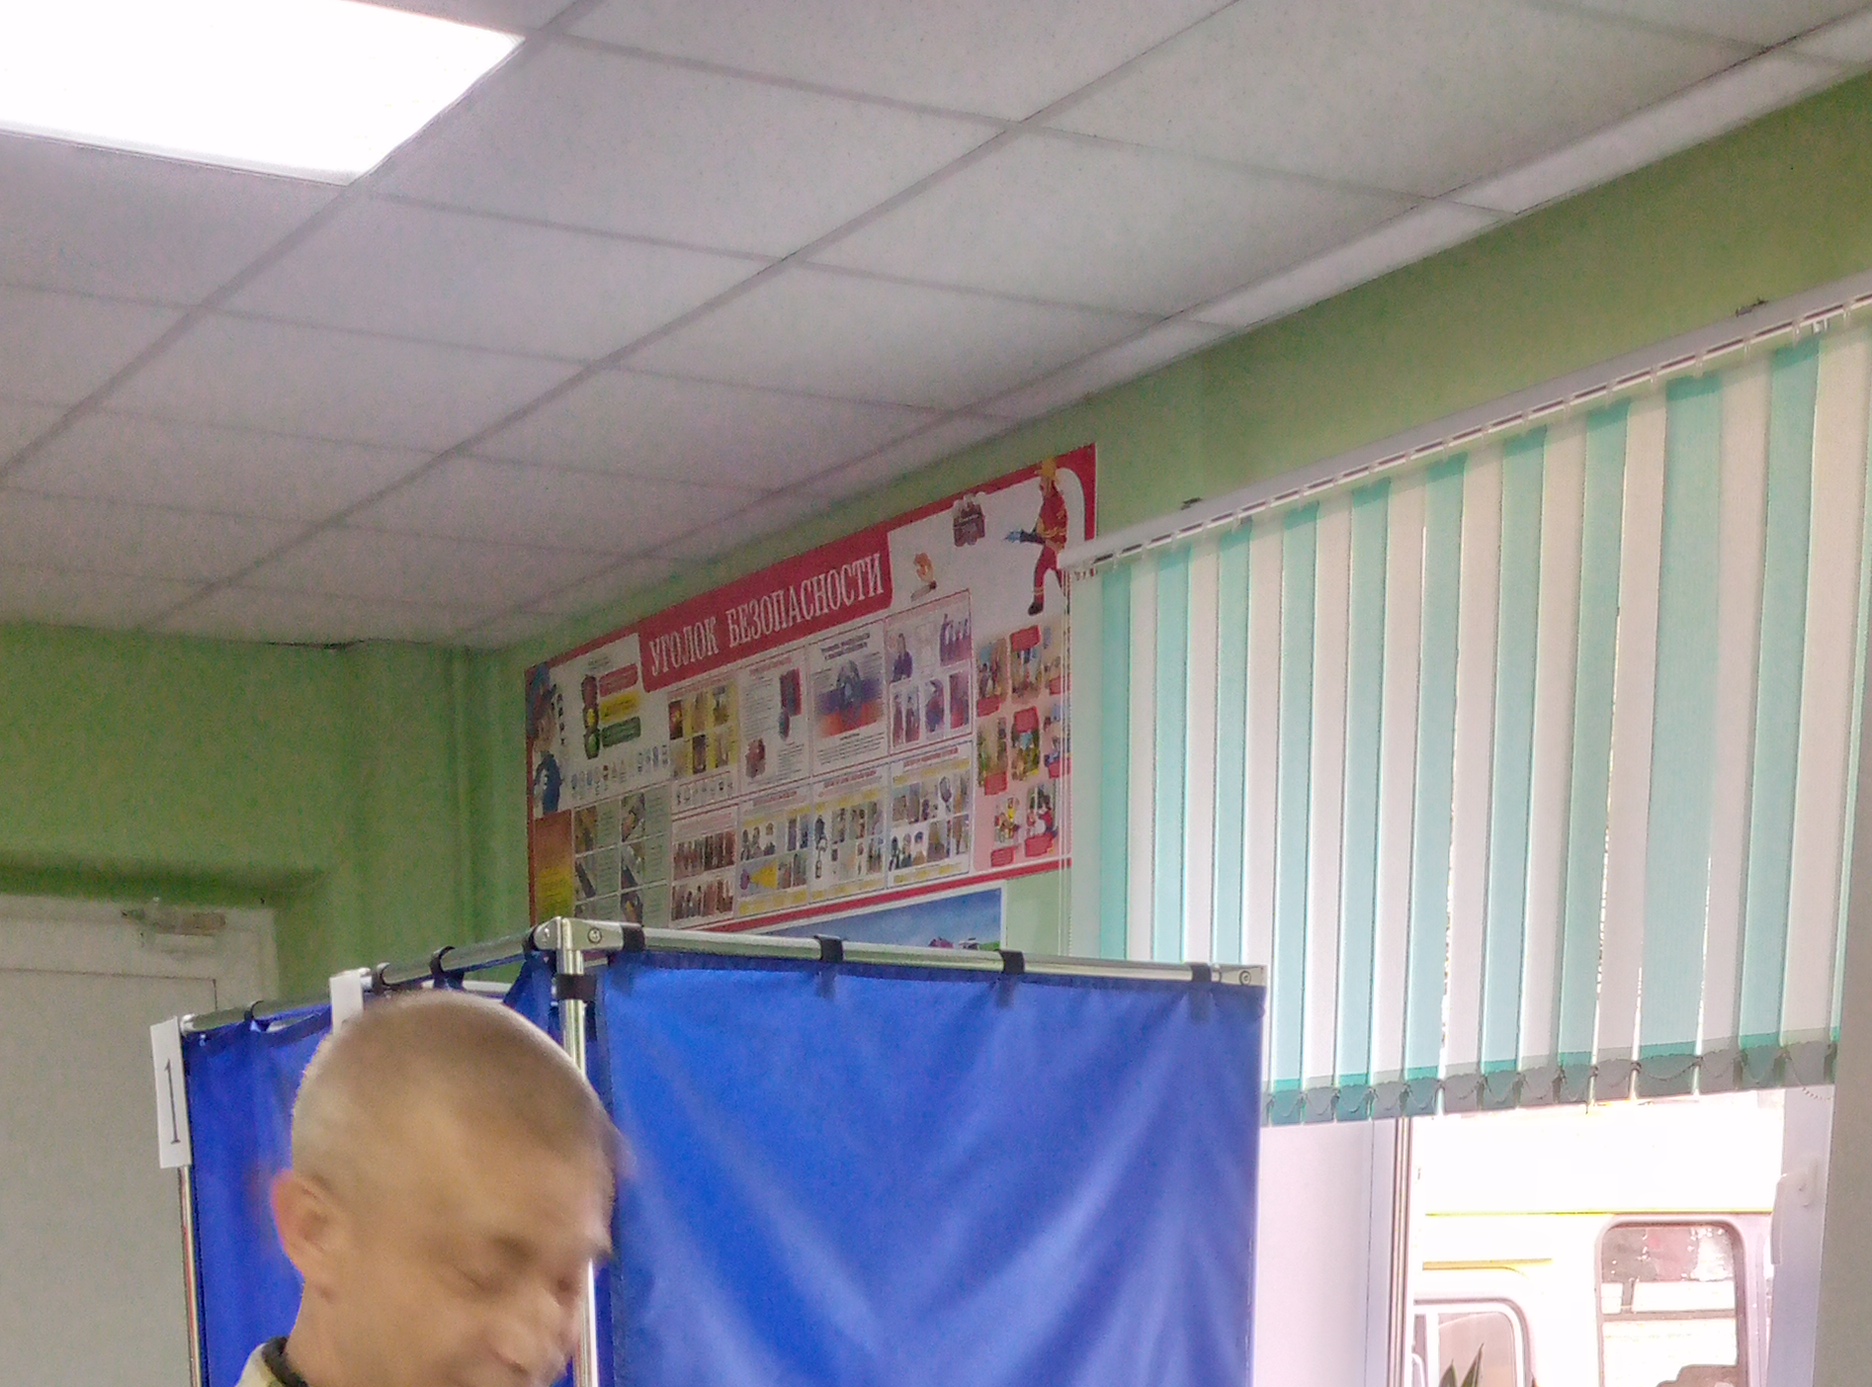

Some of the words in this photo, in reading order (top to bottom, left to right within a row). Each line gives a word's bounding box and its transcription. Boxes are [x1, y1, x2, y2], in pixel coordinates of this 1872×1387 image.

[649, 616, 719, 676] УГОЛОК
[725, 553, 884, 648] БЕЗОПАСНОСТИ
[164, 1058, 181, 1145] 1
